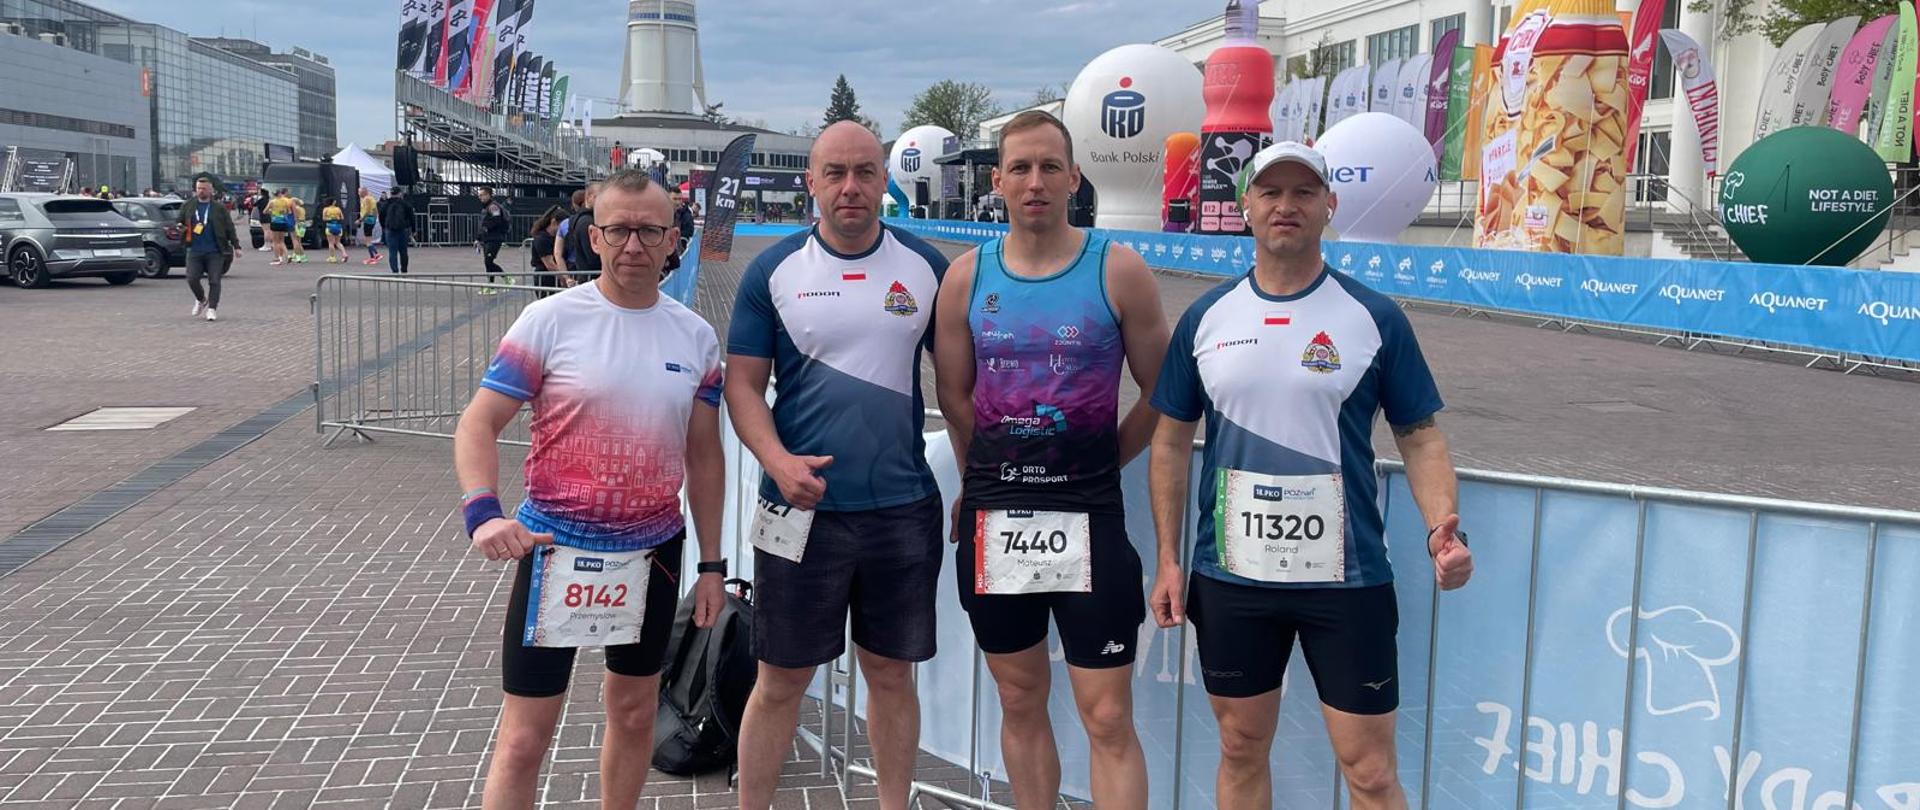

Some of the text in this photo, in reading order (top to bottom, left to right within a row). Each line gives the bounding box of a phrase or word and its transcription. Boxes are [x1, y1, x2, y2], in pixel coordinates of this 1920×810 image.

[1817, 66, 1832, 86] BODY
[1854, 64, 1872, 85] BODY
[1090, 152, 1160, 162] Bank Polski
[718, 176, 740, 196] 21
[716, 194, 736, 209] km
[1809, 190, 1878, 200] NOT A DIET.
[1811, 201, 1876, 212] LIFESTYLE.
[1728, 206, 1768, 225] CHIEF
[1000, 416, 1040, 428] Omega
[1010, 424, 1056, 438] Logistic
[1022, 466, 1046, 474] ORTO
[1022, 475, 1068, 483] PROSPORT
[1241, 512, 1324, 540] 11320
[1001, 530, 1067, 554] 7440
[1264, 544, 1299, 554] Roland
[564, 584, 628, 608] 8142
